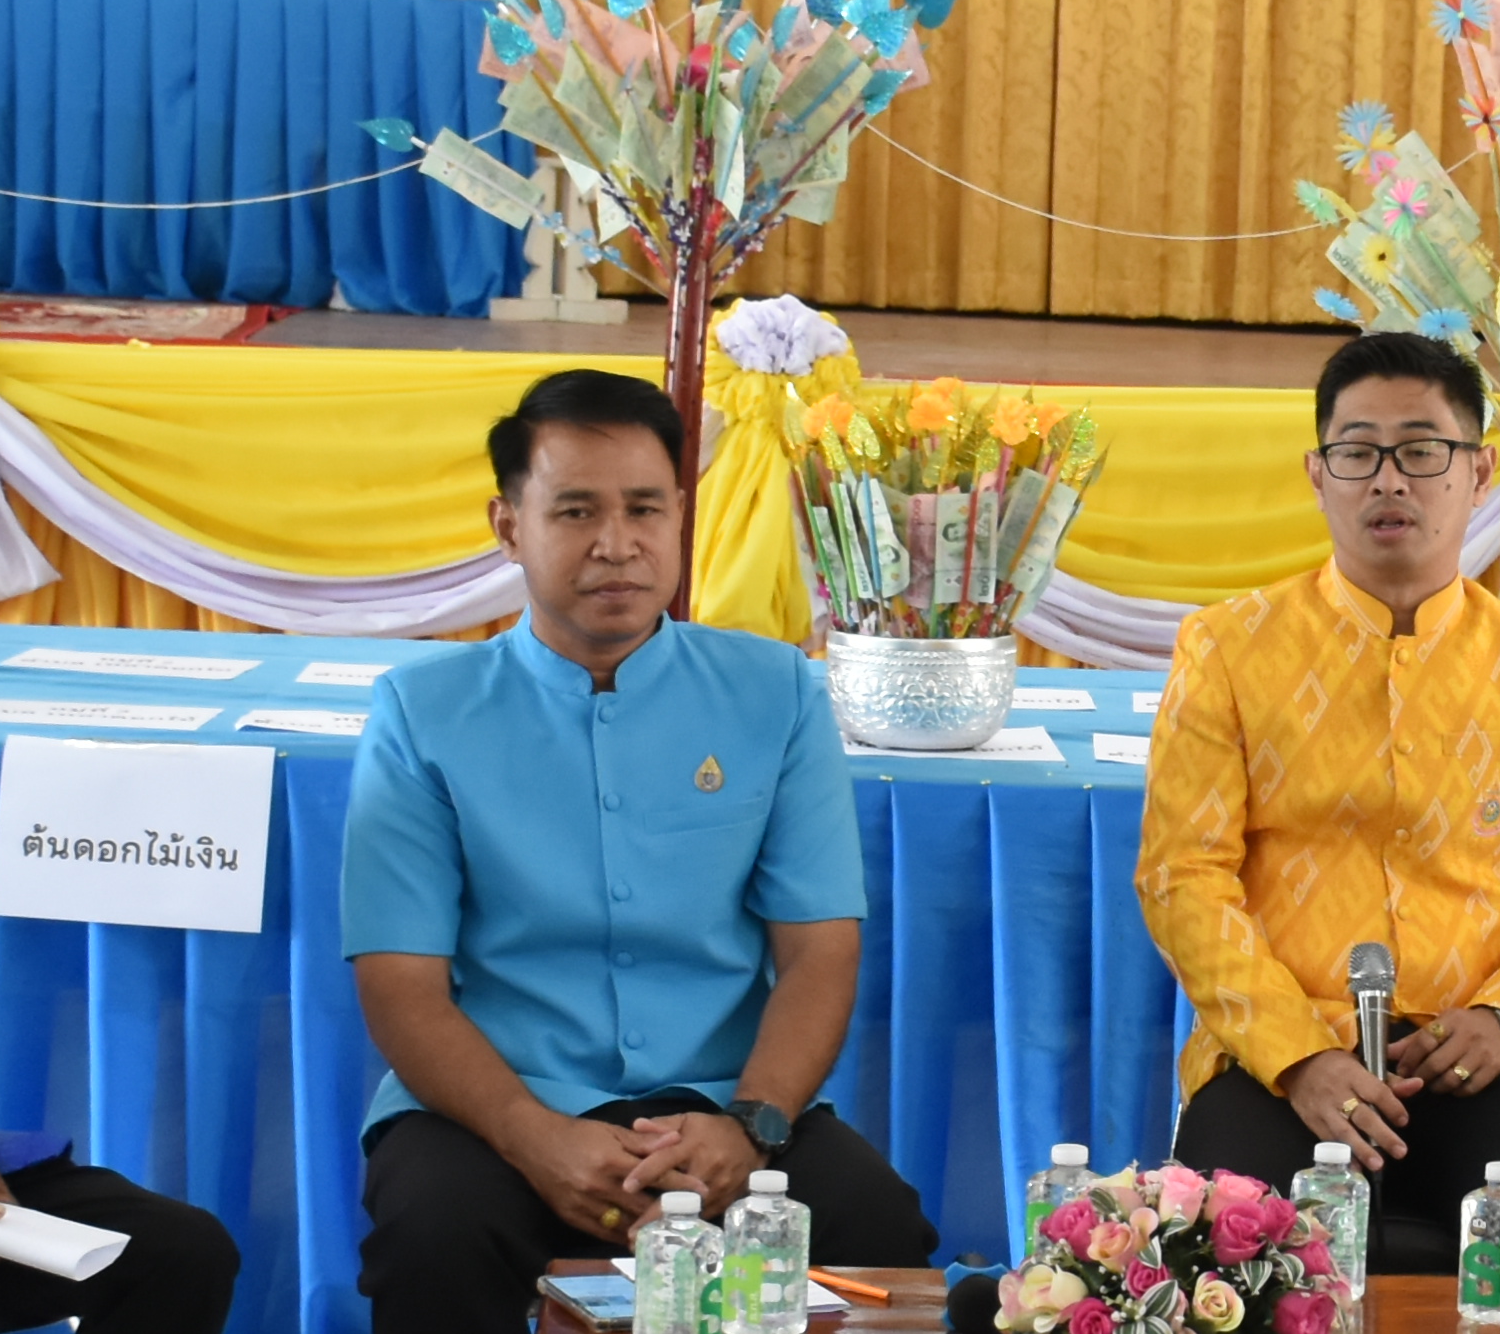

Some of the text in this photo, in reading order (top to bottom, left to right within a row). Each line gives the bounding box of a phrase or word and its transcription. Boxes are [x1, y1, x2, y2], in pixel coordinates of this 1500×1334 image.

[22, 823, 240, 872] ต้นดอกไม้เงิน
